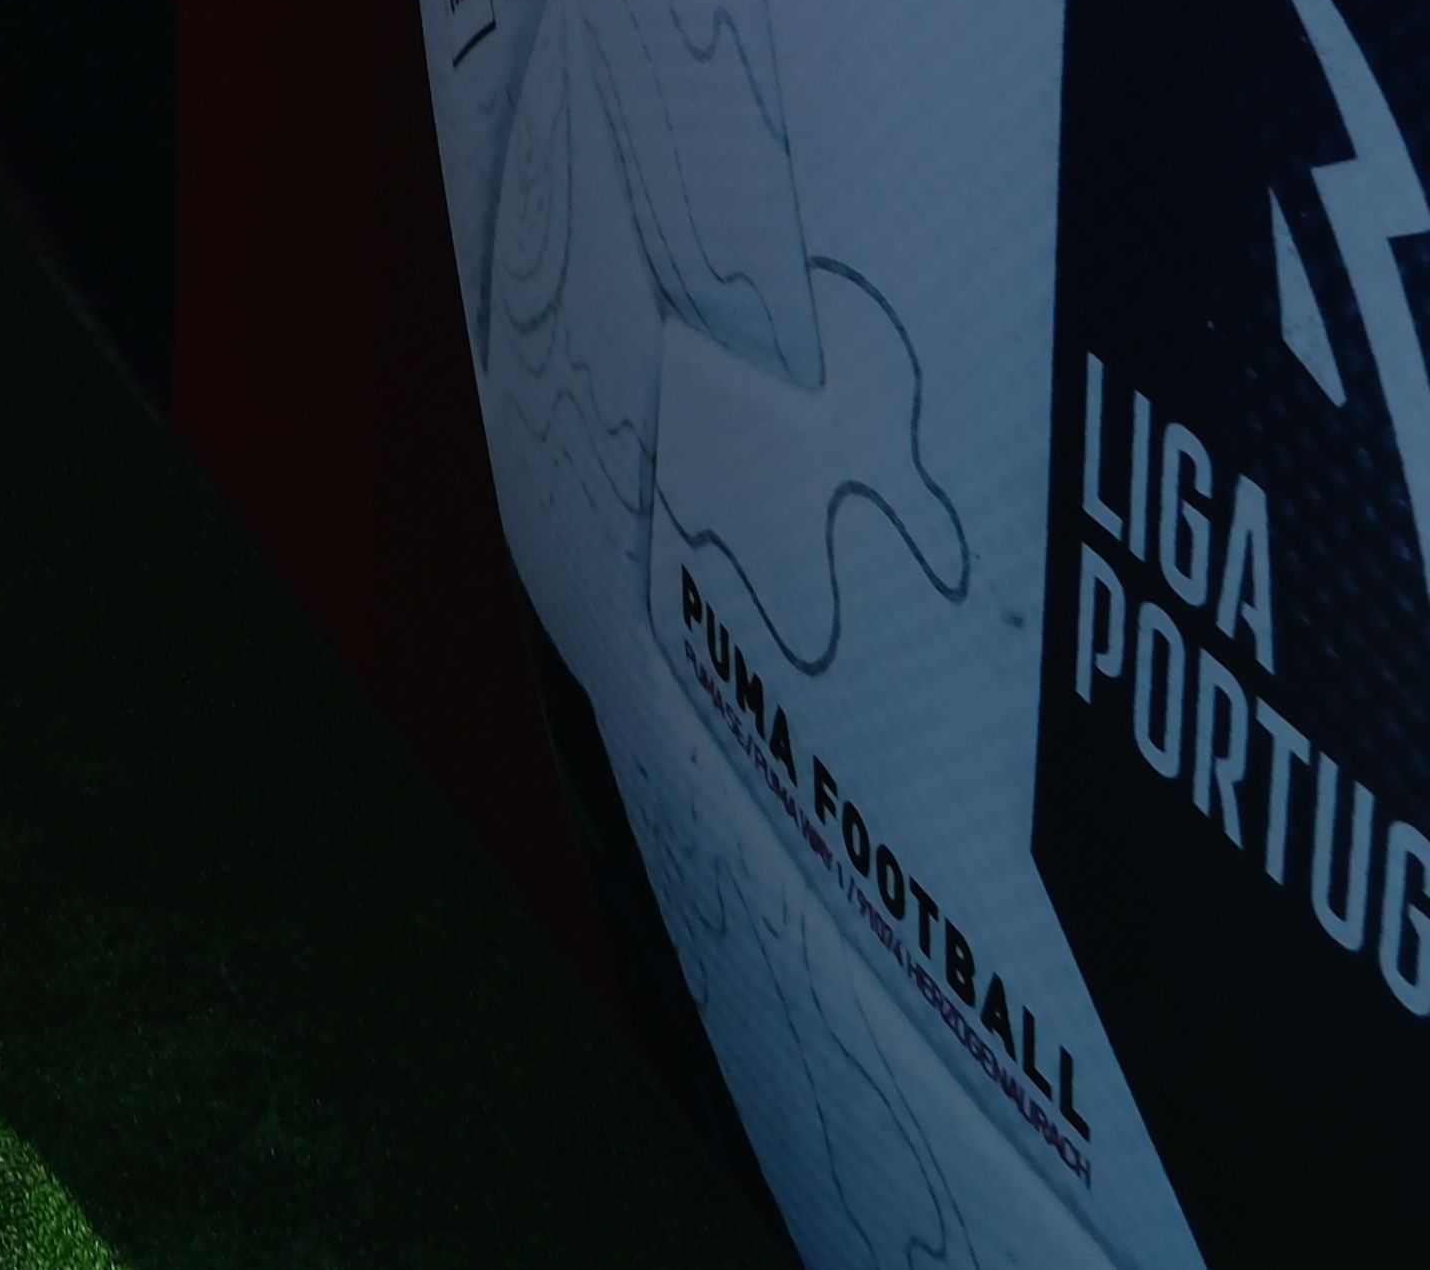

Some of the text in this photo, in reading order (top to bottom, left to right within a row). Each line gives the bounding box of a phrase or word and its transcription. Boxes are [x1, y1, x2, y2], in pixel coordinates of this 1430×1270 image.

[1081, 351, 1276, 675] LIGA
[681, 563, 1091, 1143] PUMA FOOTBALL
